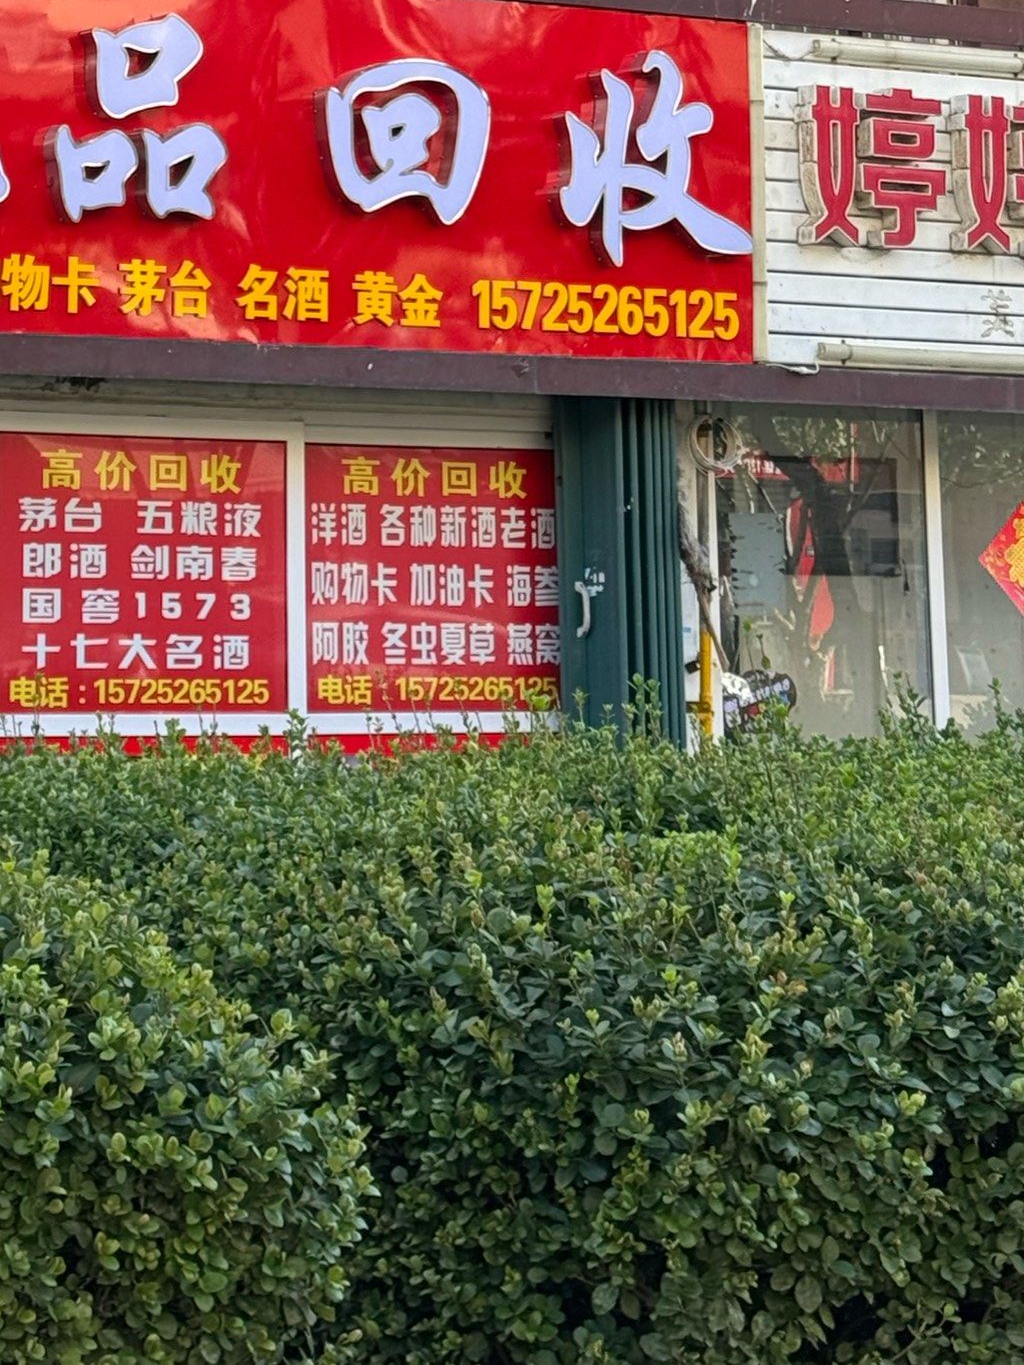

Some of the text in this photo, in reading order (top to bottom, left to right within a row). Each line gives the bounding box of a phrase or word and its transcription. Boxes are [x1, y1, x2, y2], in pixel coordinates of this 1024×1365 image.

[117, 257, 212, 322] 茅台
[237, 264, 329, 323] 名酒
[352, 269, 444, 329] 黄金
[471, 278, 741, 342] 15725265125
[40, 448, 242, 494] 高价回收
[341, 456, 528, 499] 高价回收
[18, 496, 262, 537] 茅台 五粮液
[311, 502, 556, 549] 洋酒 各种新酒老酒
[22, 542, 257, 582] 郎酒 剑南春
[311, 561, 560, 608] 购物卡 加油卡 海参
[21, 633, 250, 670] 十七大名酒
[311, 621, 561, 667] 阿胶 冬虫夏草 燕窝
